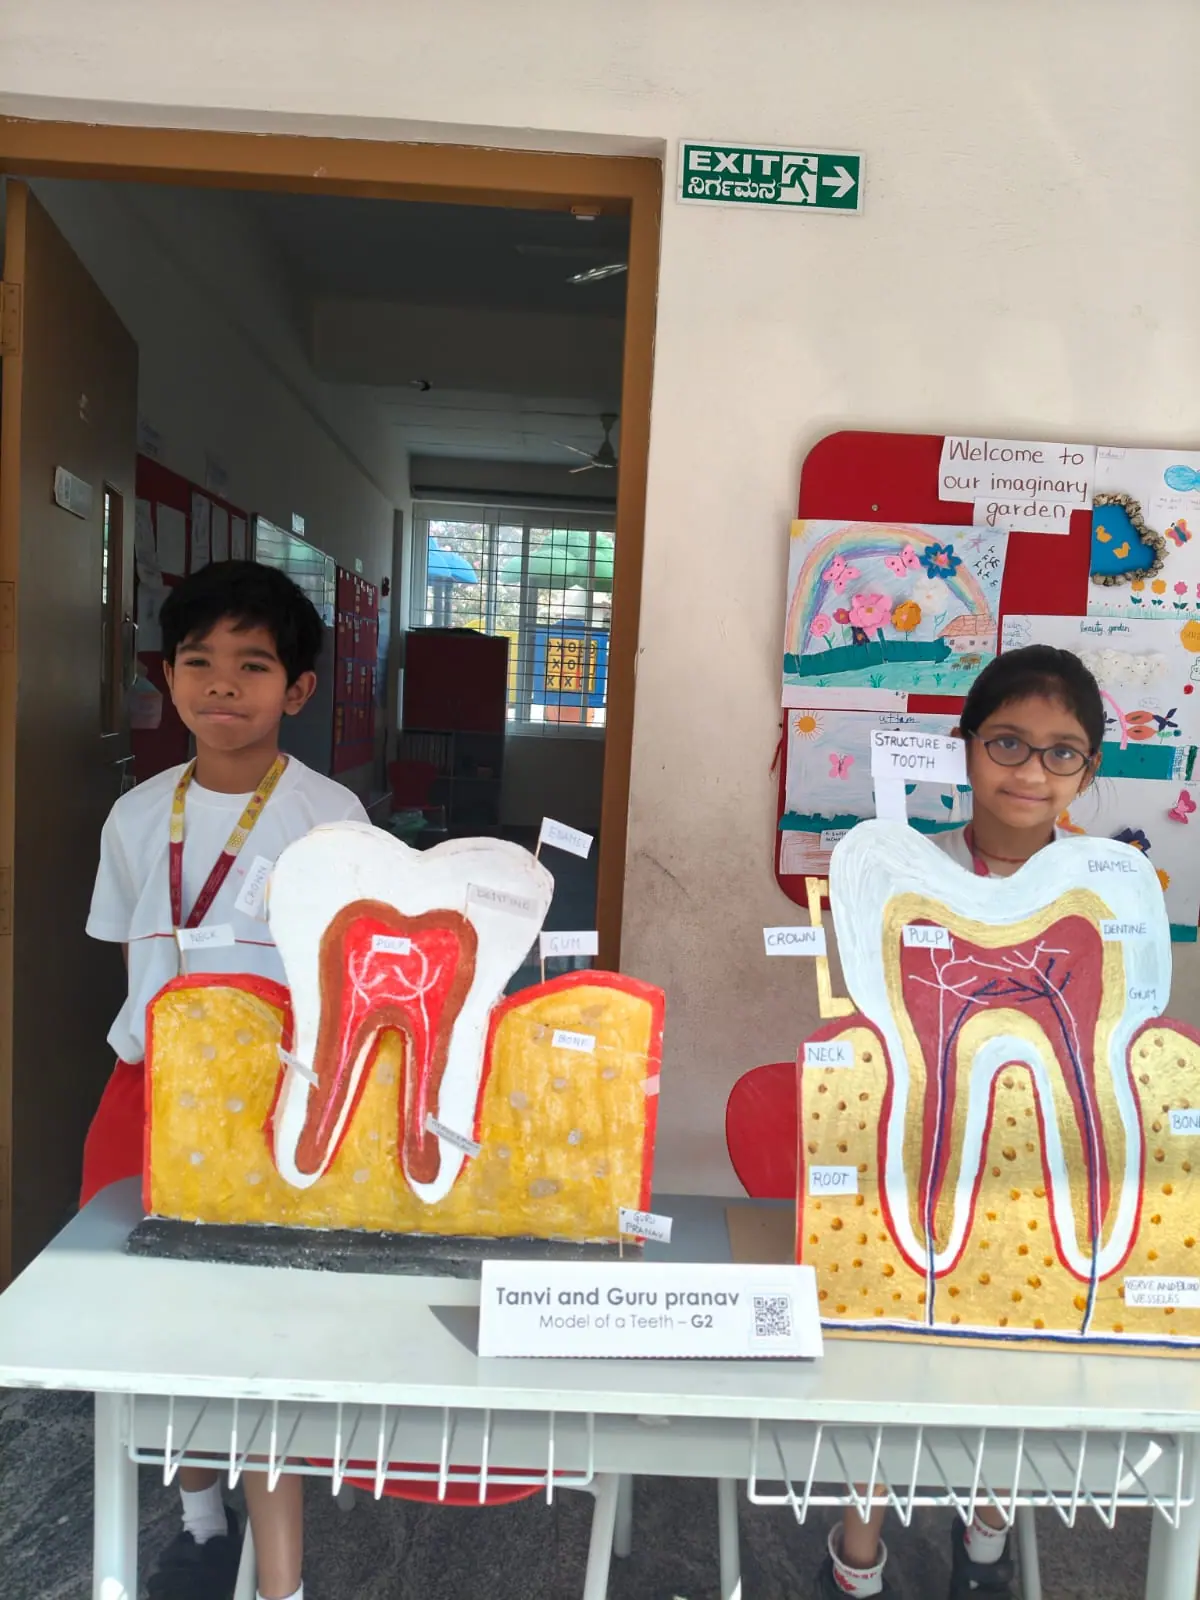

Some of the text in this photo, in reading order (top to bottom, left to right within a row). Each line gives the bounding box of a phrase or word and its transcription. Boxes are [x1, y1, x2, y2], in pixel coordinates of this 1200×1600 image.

[688, 150, 780, 176] EXIT
[688, 175, 776, 199] ನಿರ್ಗಮನ
[949, 439, 1044, 464] Welcome
[1059, 447, 1084, 465] to
[943, 473, 1088, 502] our imaginary
[986, 502, 1066, 527] garden
[875, 732, 940, 750] STRUCTURE
[891, 753, 935, 769] TOOTH
[1087, 859, 1138, 873] ENAMEL
[908, 927, 945, 945] PULP
[1103, 922, 1147, 935] DENTINE
[550, 936, 581, 952] GUM
[767, 931, 816, 947] CROWN
[807, 1047, 845, 1062] NECK
[1172, 1114, 1200, 1130] BON
[812, 1171, 850, 1187] ROOT
[495, 1286, 740, 1314] Tanvi and Guru pranav
[539, 1313, 590, 1329] Model
[594, 1313, 613, 1329] of
[615, 1317, 626, 1329] a
[630, 1313, 674, 1330] Teeth
[690, 1314, 713, 1329] G2
